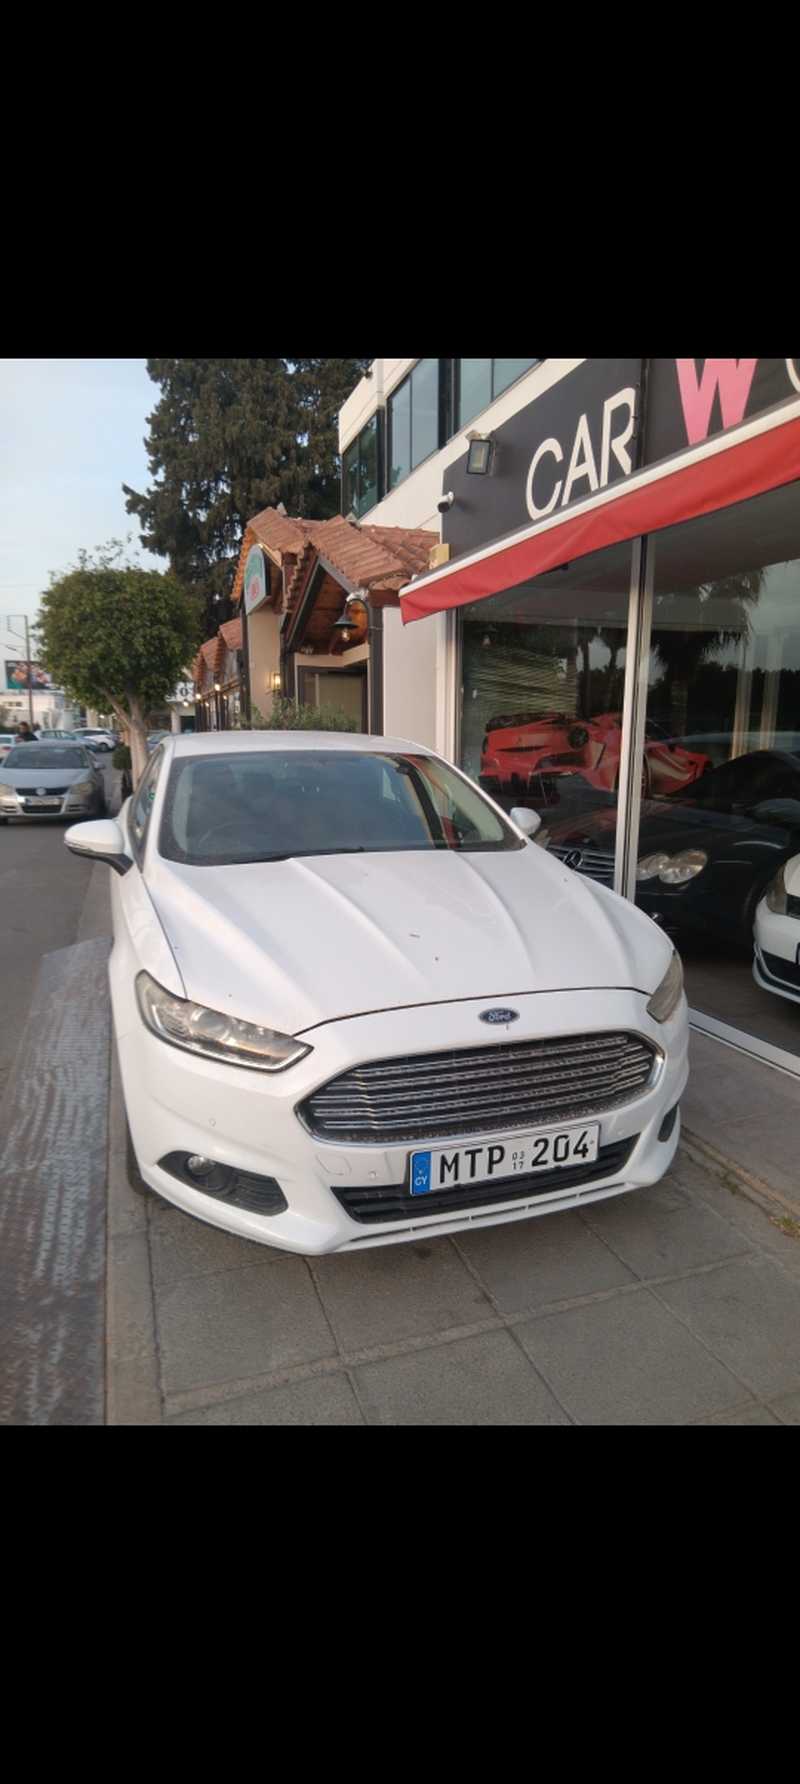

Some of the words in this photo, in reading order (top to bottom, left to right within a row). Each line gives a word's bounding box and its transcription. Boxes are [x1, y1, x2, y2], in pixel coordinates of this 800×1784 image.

[526, 387, 636, 521] CAR
[487, 1010, 512, 1022] Ford
[439, 1145, 506, 1184] MTP
[531, 1130, 589, 1168] 204
[512, 1161, 524, 1170] 17
[415, 1174, 429, 1187] CY
